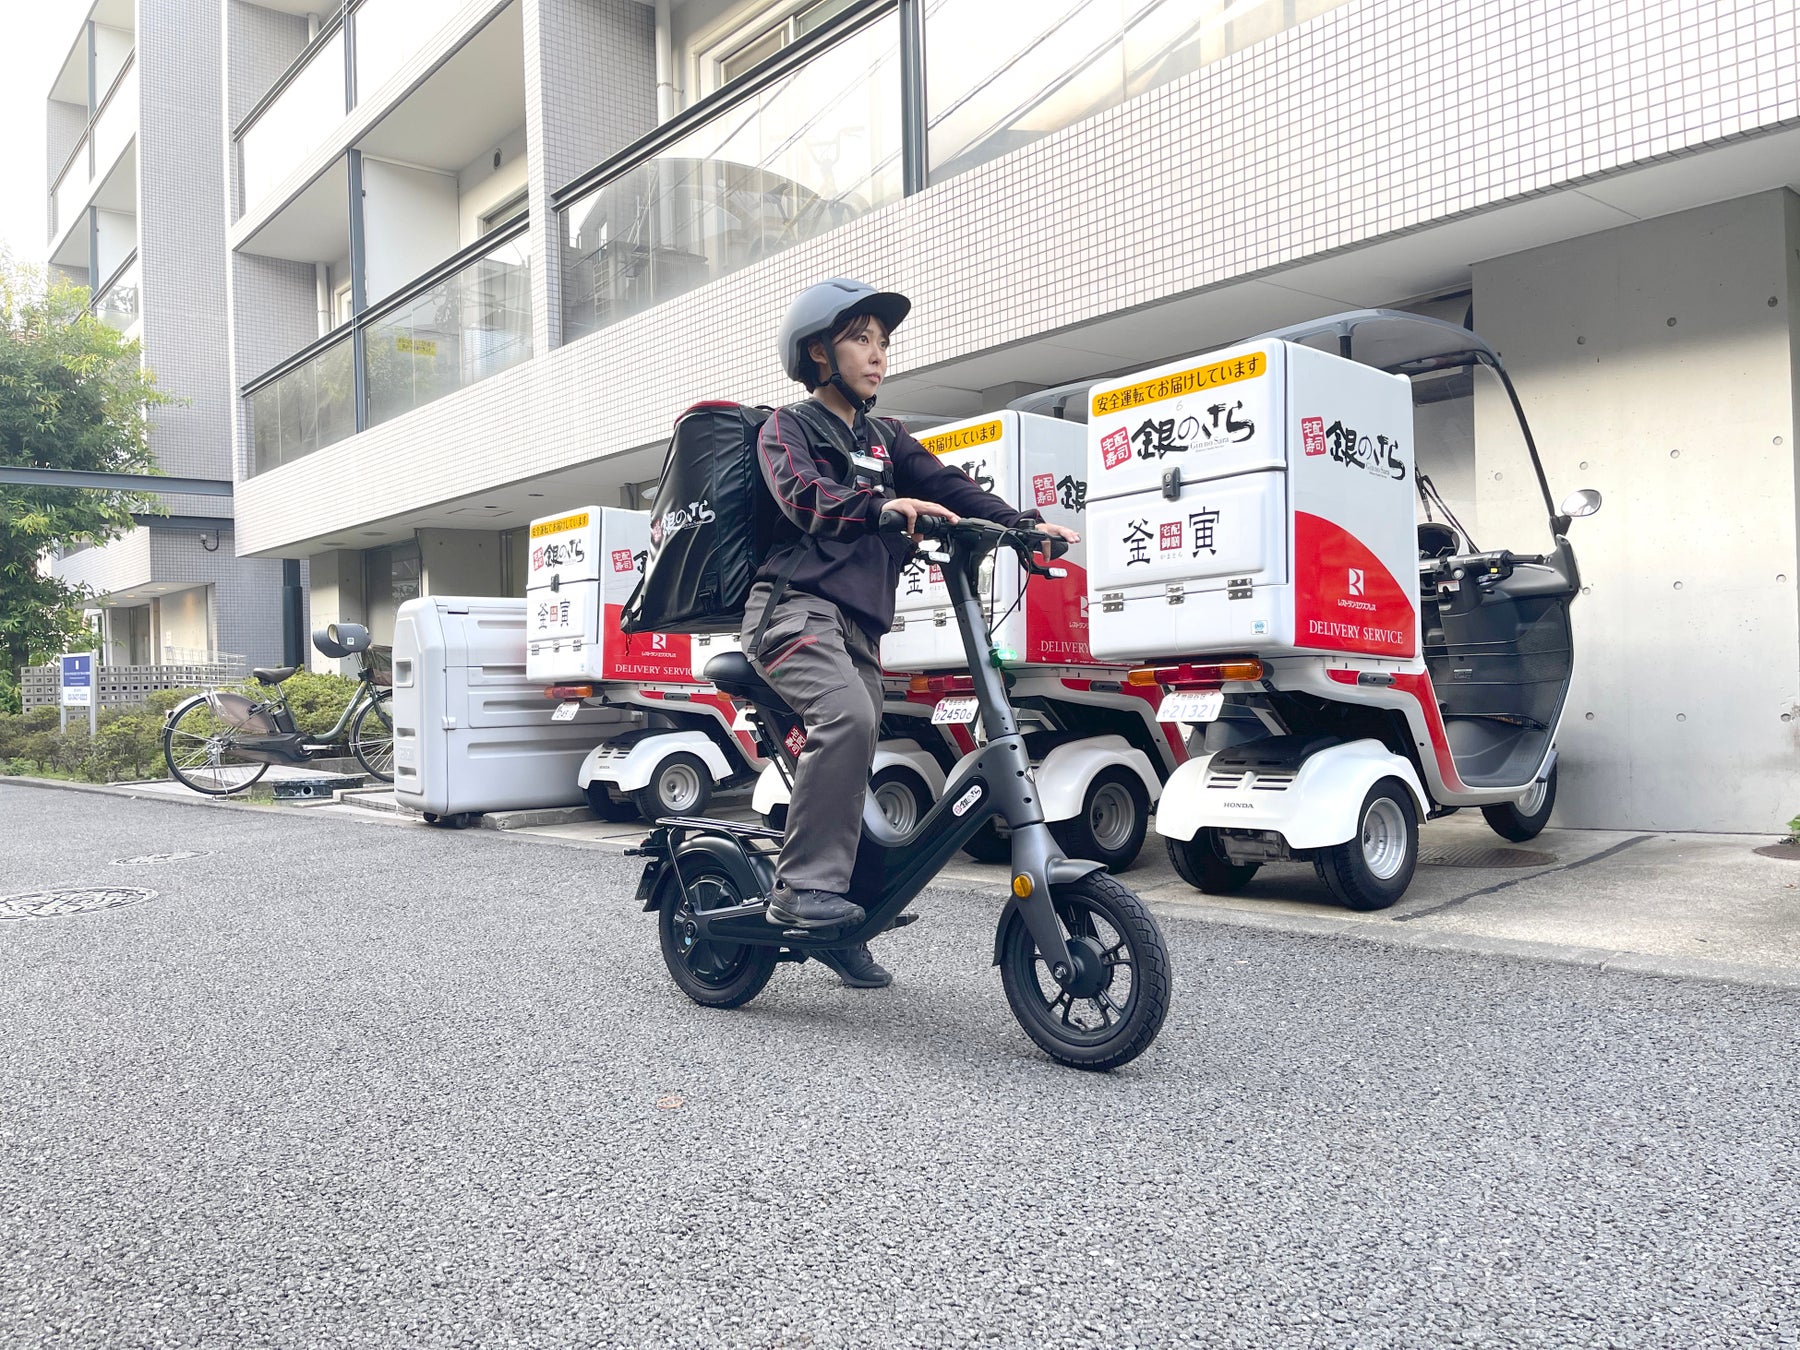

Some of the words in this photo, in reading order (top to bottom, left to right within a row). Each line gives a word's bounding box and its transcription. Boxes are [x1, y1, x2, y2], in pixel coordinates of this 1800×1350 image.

[1097, 356, 1259, 413] 安全運転でお届けしています
[1131, 400, 1255, 460] 銀のさら
[1325, 420, 1406, 480] 銀のさら
[1123, 518, 1154, 566] 釜
[1189, 506, 1220, 558] 寅
[1309, 619, 1360, 639] DELIVERY
[1363, 626, 1404, 644] SERVICE
[615, 663, 661, 675] DELIVERY
